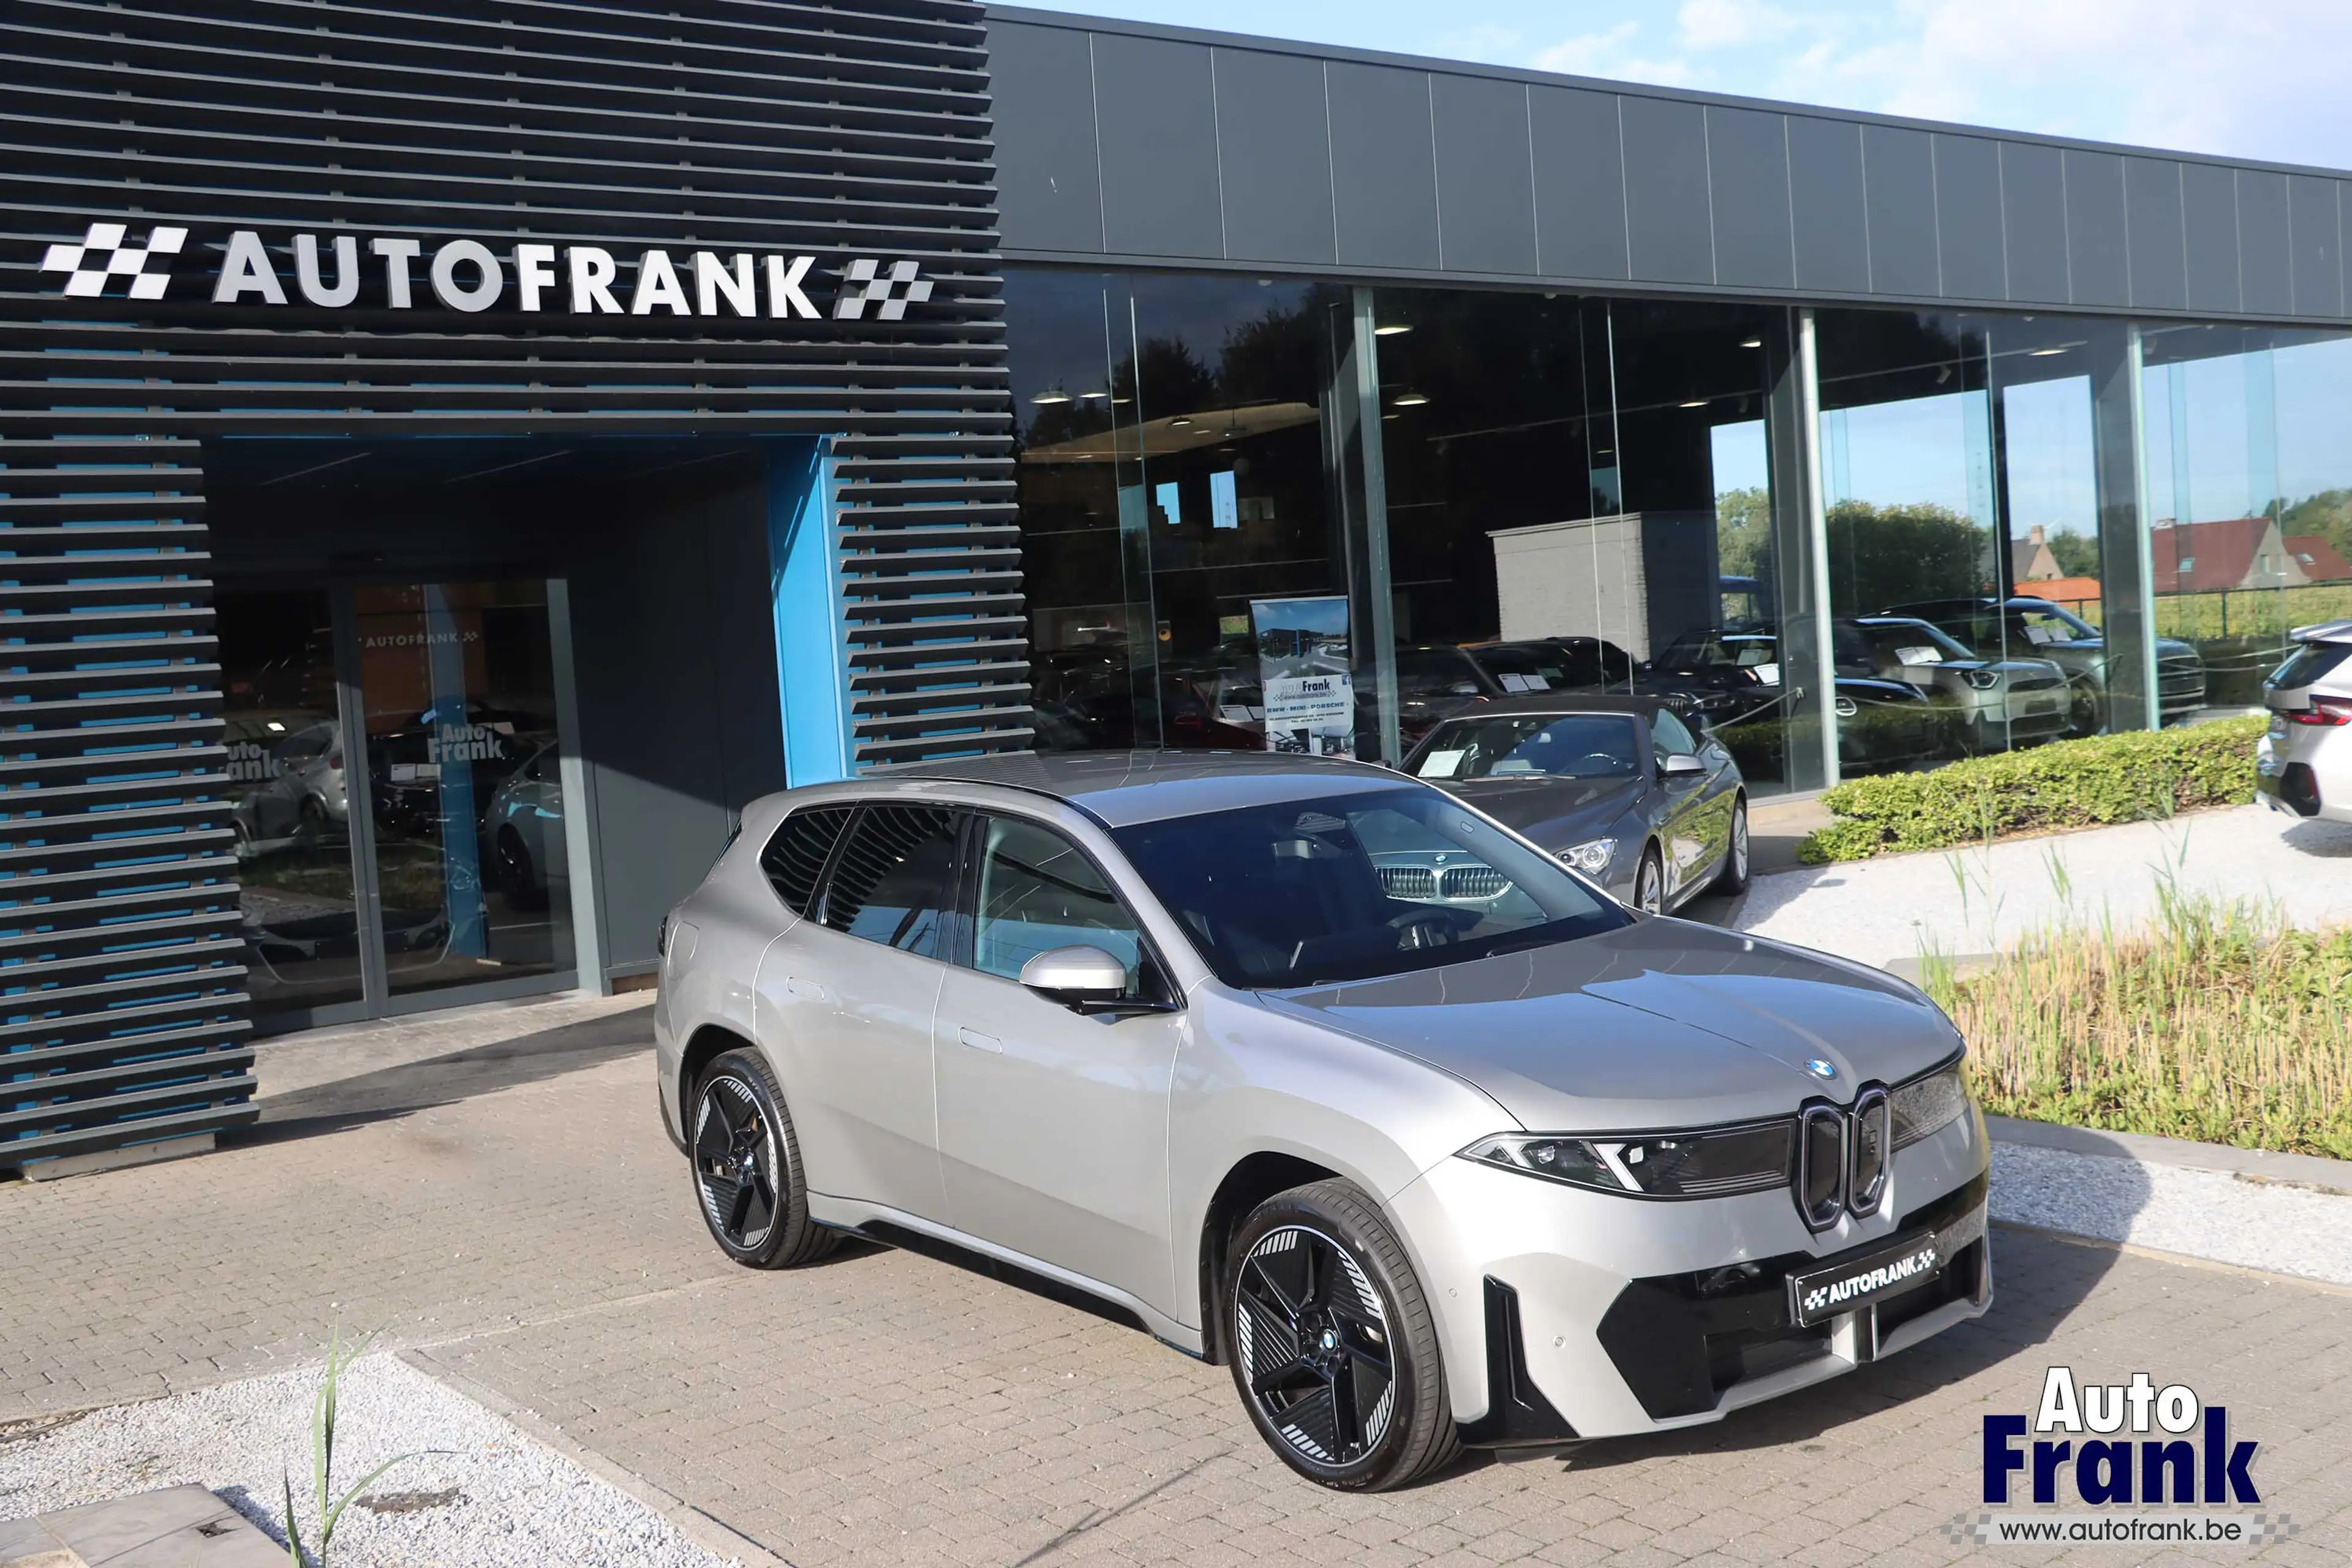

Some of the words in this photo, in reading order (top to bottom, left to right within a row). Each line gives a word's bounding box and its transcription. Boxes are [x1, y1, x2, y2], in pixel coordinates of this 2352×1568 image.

[211, 230, 822, 319] AUTOFRANK
[366, 633, 458, 648] AUTOFRANK
[1302, 678, 1330, 692] Frank
[442, 723, 486, 742] Auto
[227, 741, 262, 760] uto
[428, 731, 503, 763] Frank
[219, 750, 281, 781] ank
[1829, 1256, 1917, 1304] AUTOFRANK
